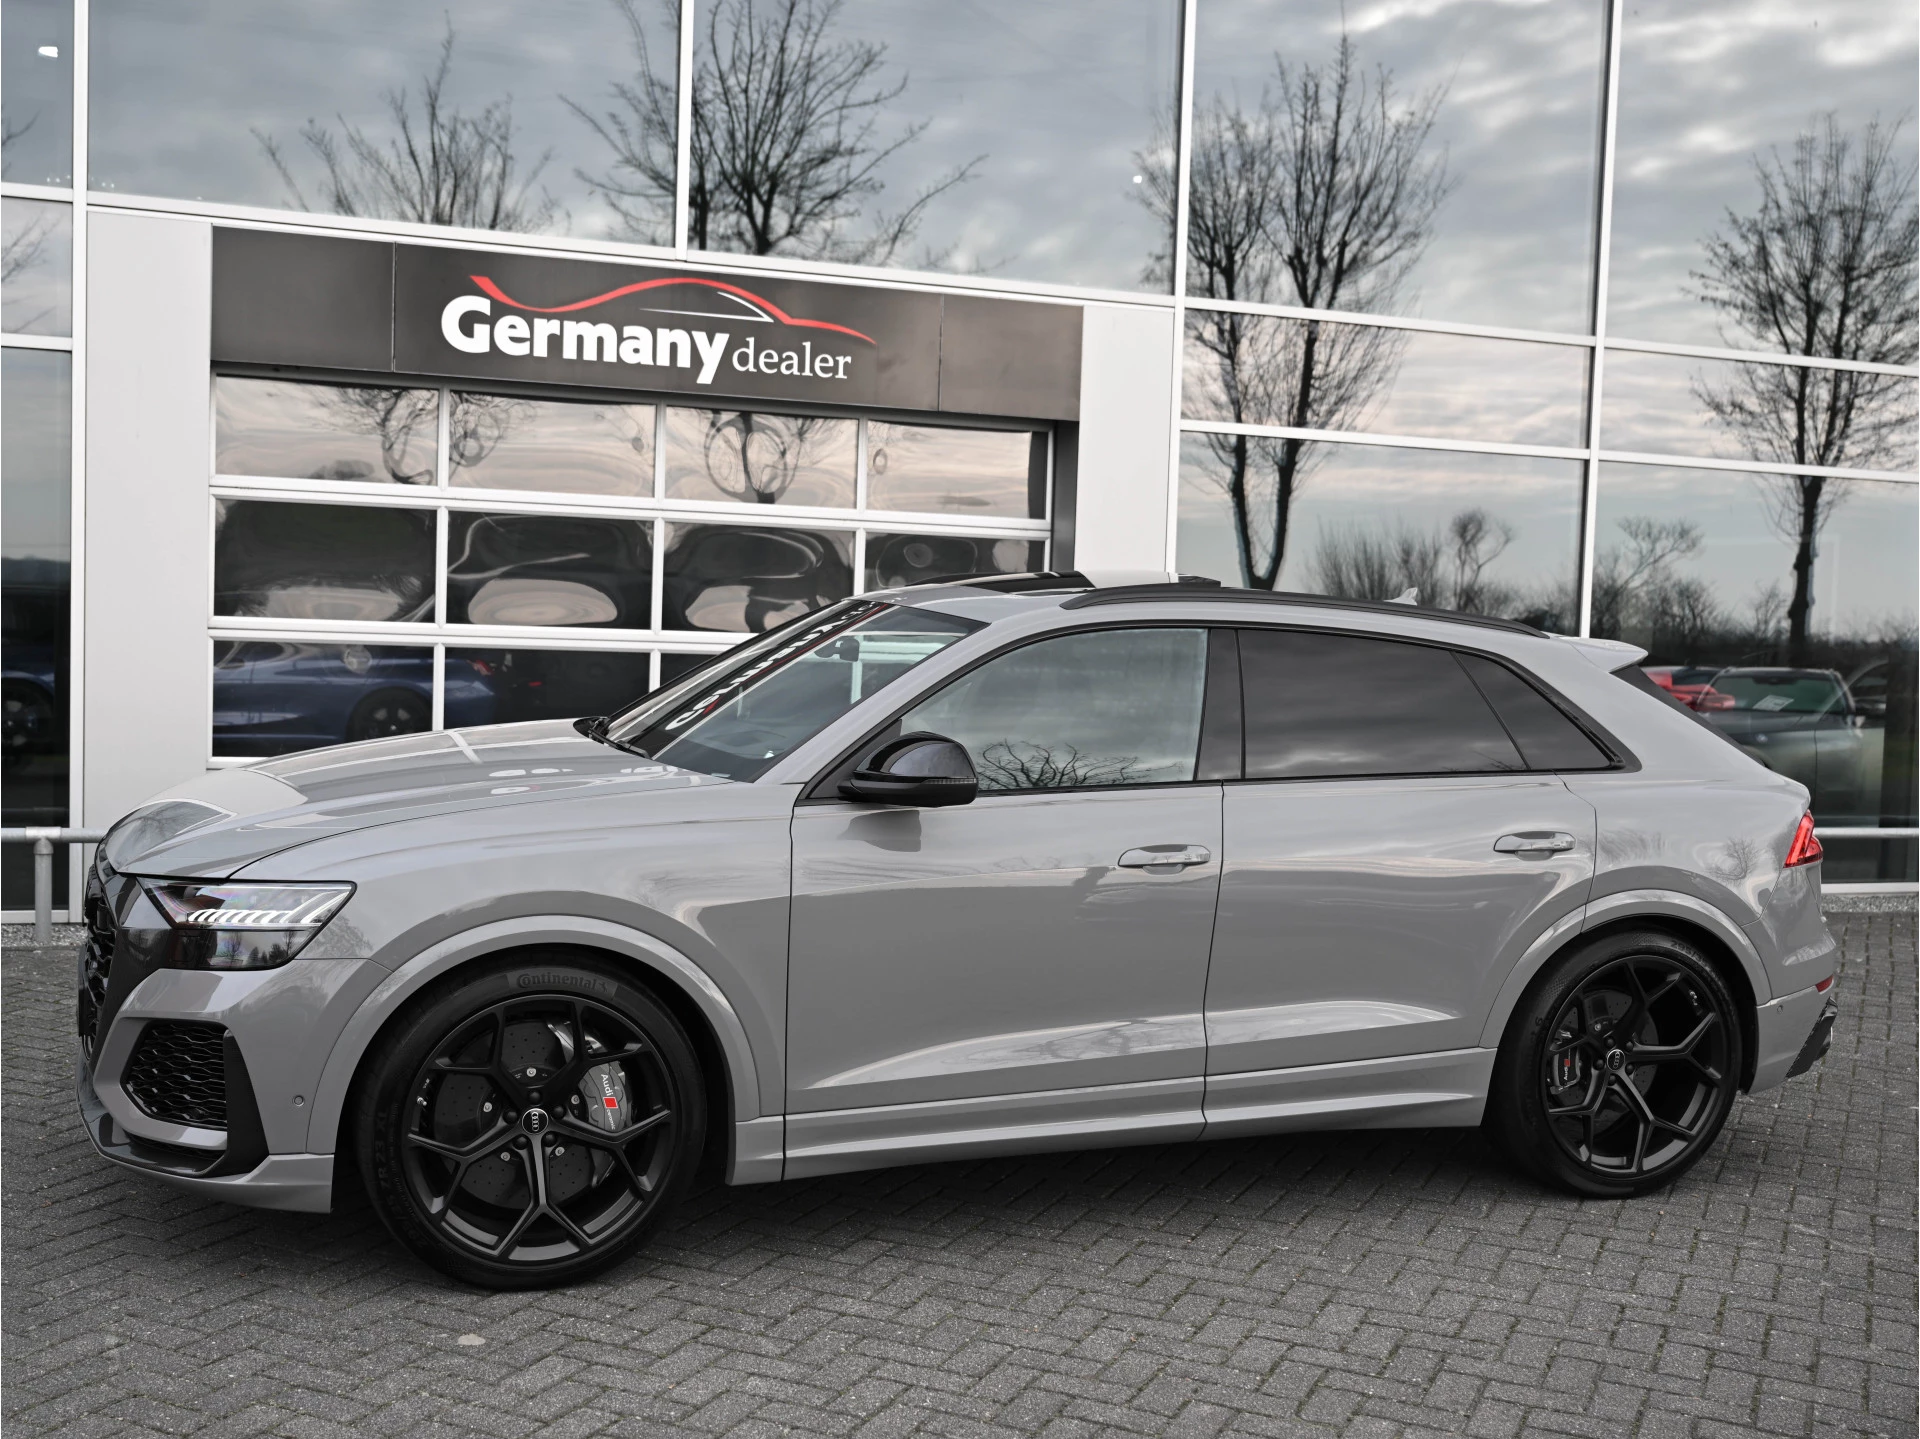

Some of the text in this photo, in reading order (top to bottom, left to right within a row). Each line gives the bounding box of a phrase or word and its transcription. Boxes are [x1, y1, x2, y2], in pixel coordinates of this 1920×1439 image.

[441, 295, 852, 385] Germany dealer
[516, 971, 597, 990] Continental
[601, 1073, 614, 1096] Audi
